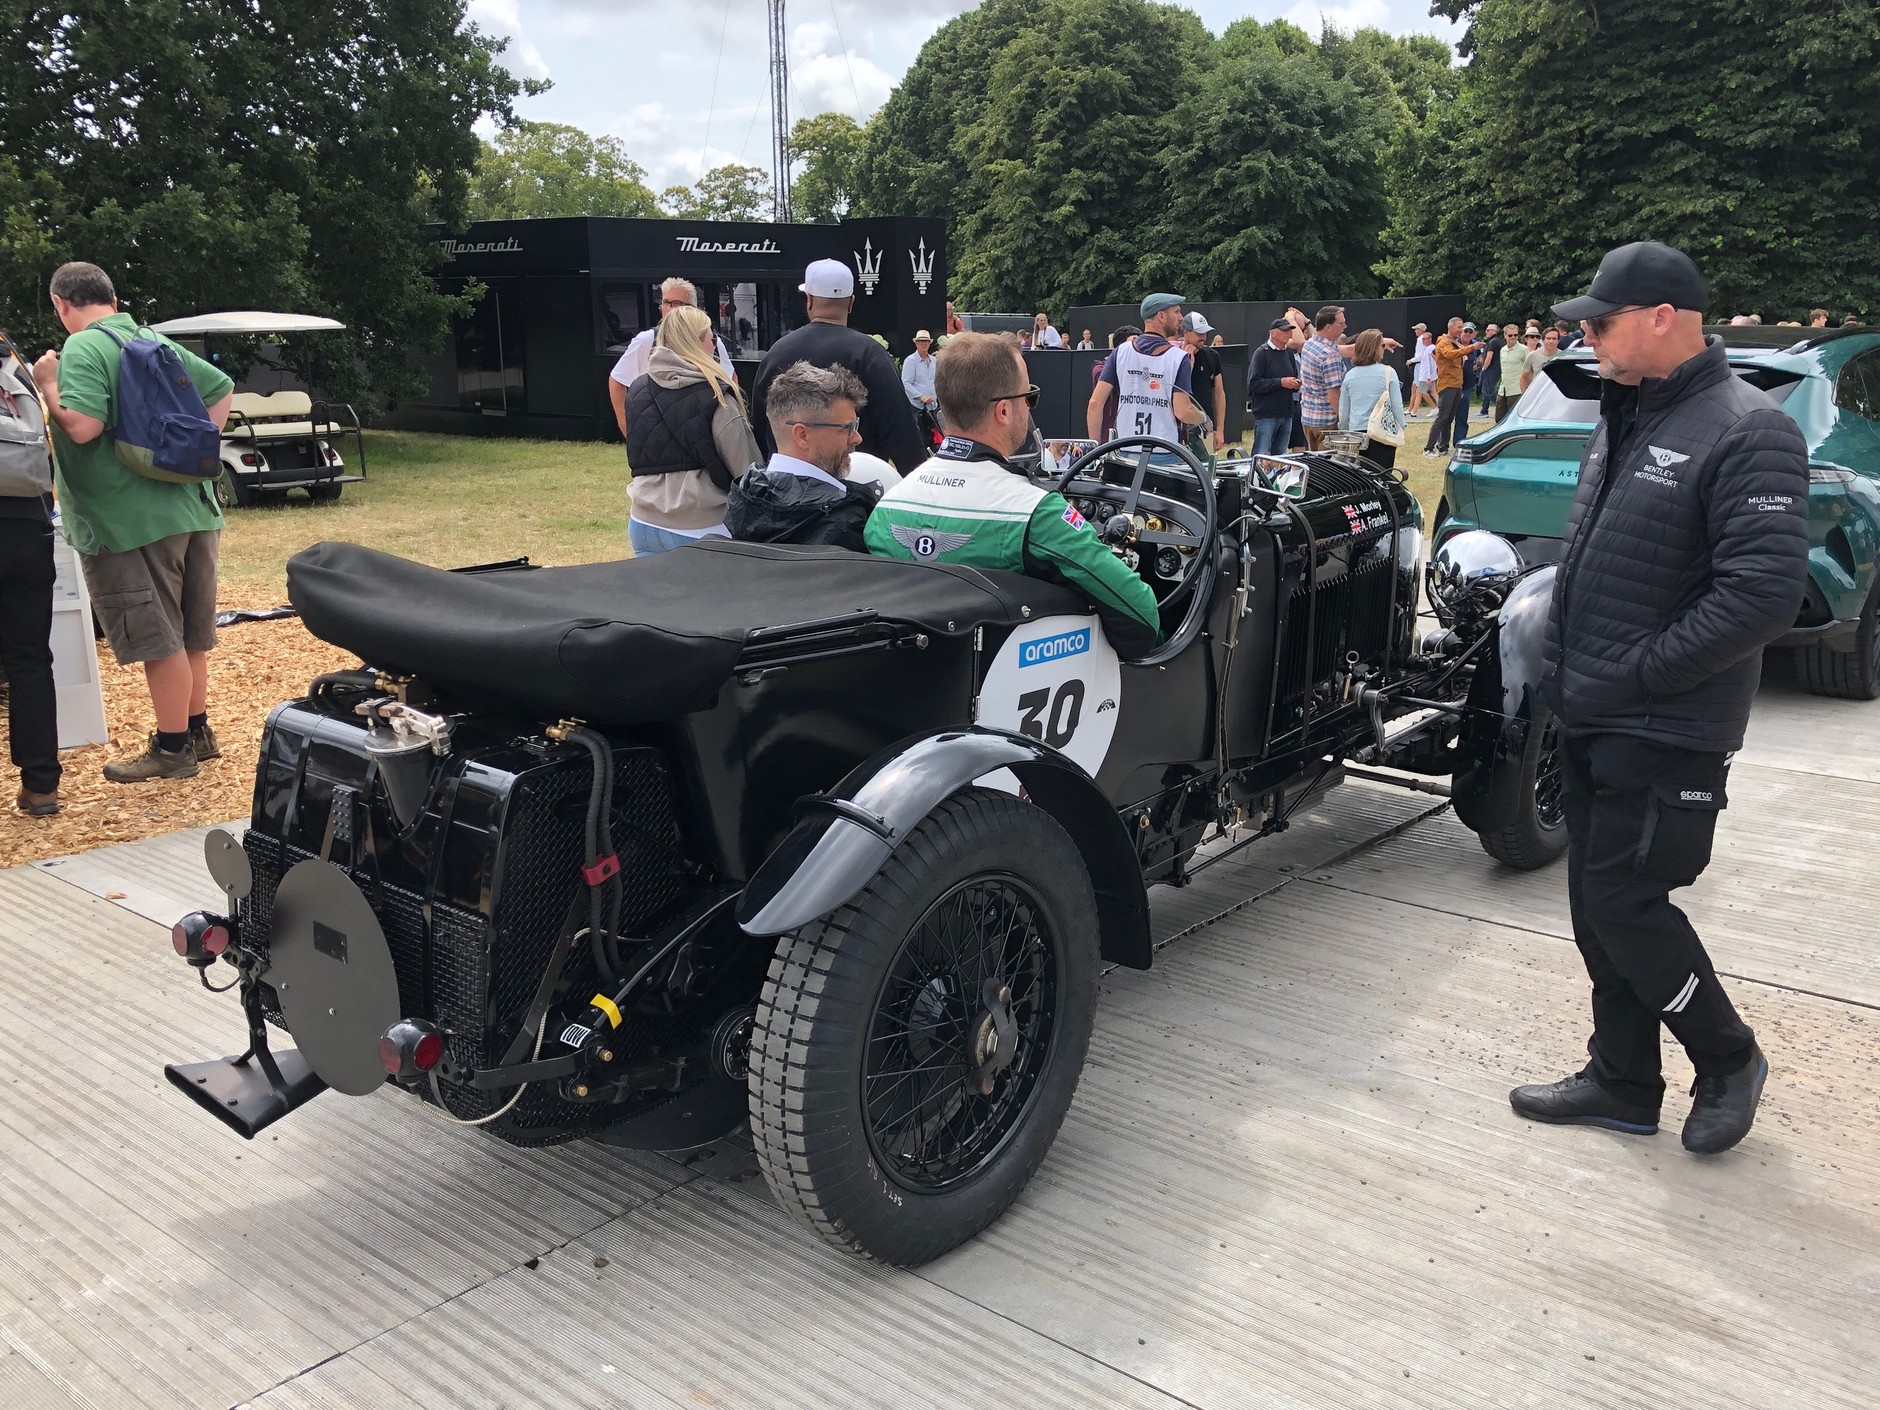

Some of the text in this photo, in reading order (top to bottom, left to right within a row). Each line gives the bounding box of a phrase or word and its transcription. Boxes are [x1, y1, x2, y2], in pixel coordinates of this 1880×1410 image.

[440, 237, 523, 253] Maserati
[676, 237, 781, 253] Maserati
[1134, 412, 1152, 436] 51
[1643, 464, 1675, 477] BENTLEY
[917, 475, 966, 488] MULLINER
[1634, 470, 1678, 488] MOTORSPORT
[1748, 496, 1793, 504] MULLINER
[1758, 503, 1787, 511] Classic
[1026, 633, 1085, 662] aramco
[1018, 679, 1085, 750] 30
[1680, 790, 1713, 801] sparco
